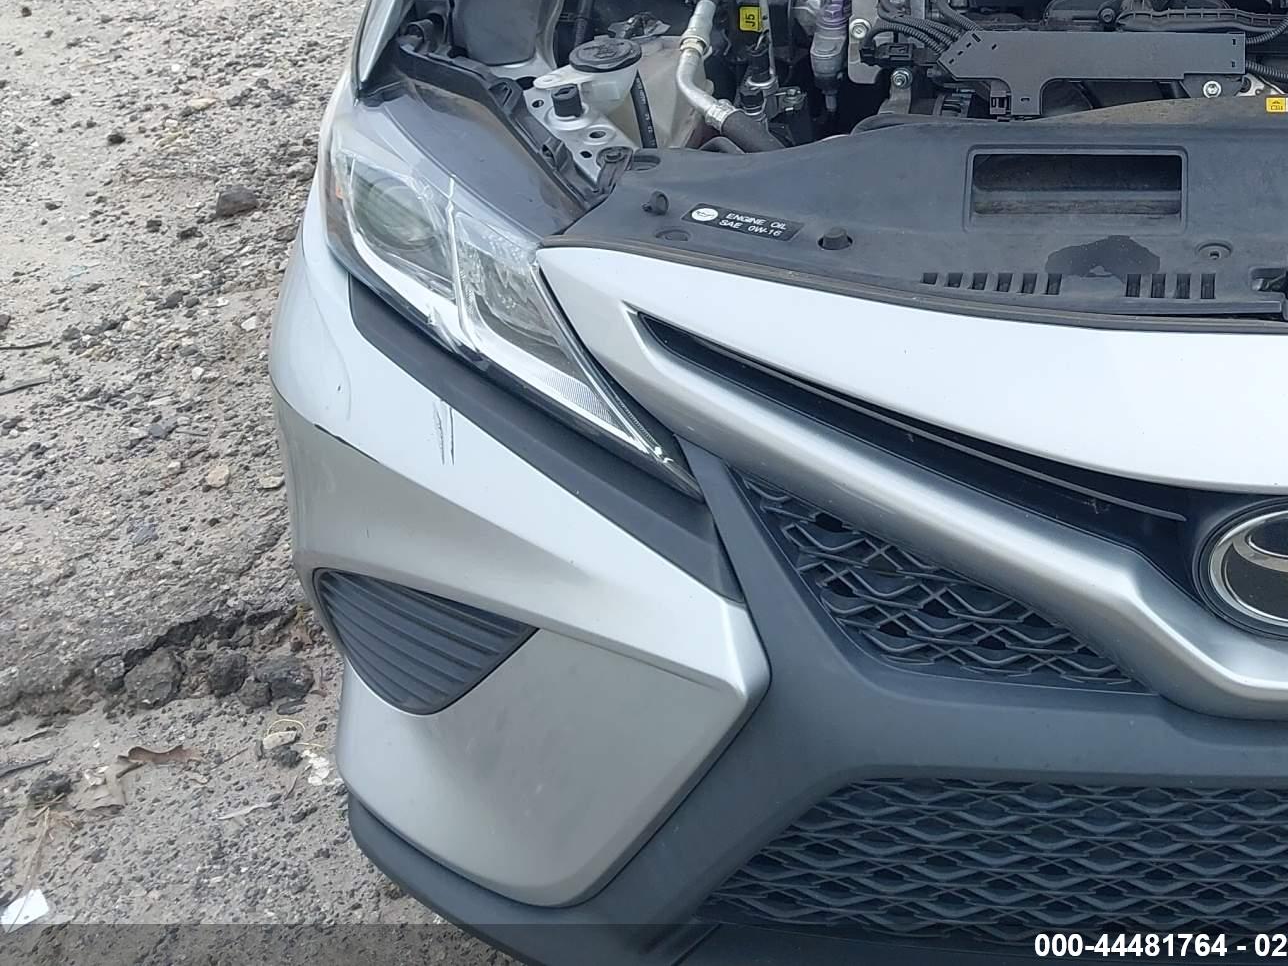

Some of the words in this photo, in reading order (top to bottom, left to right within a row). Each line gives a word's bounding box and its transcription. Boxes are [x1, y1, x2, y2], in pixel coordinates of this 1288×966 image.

[745, 13, 756, 27] J5
[719, 219, 742, 229] SAE
[748, 225, 782, 237] 0W-16
[726, 213, 766, 225] ENGINE
[770, 221, 788, 230] OIL
